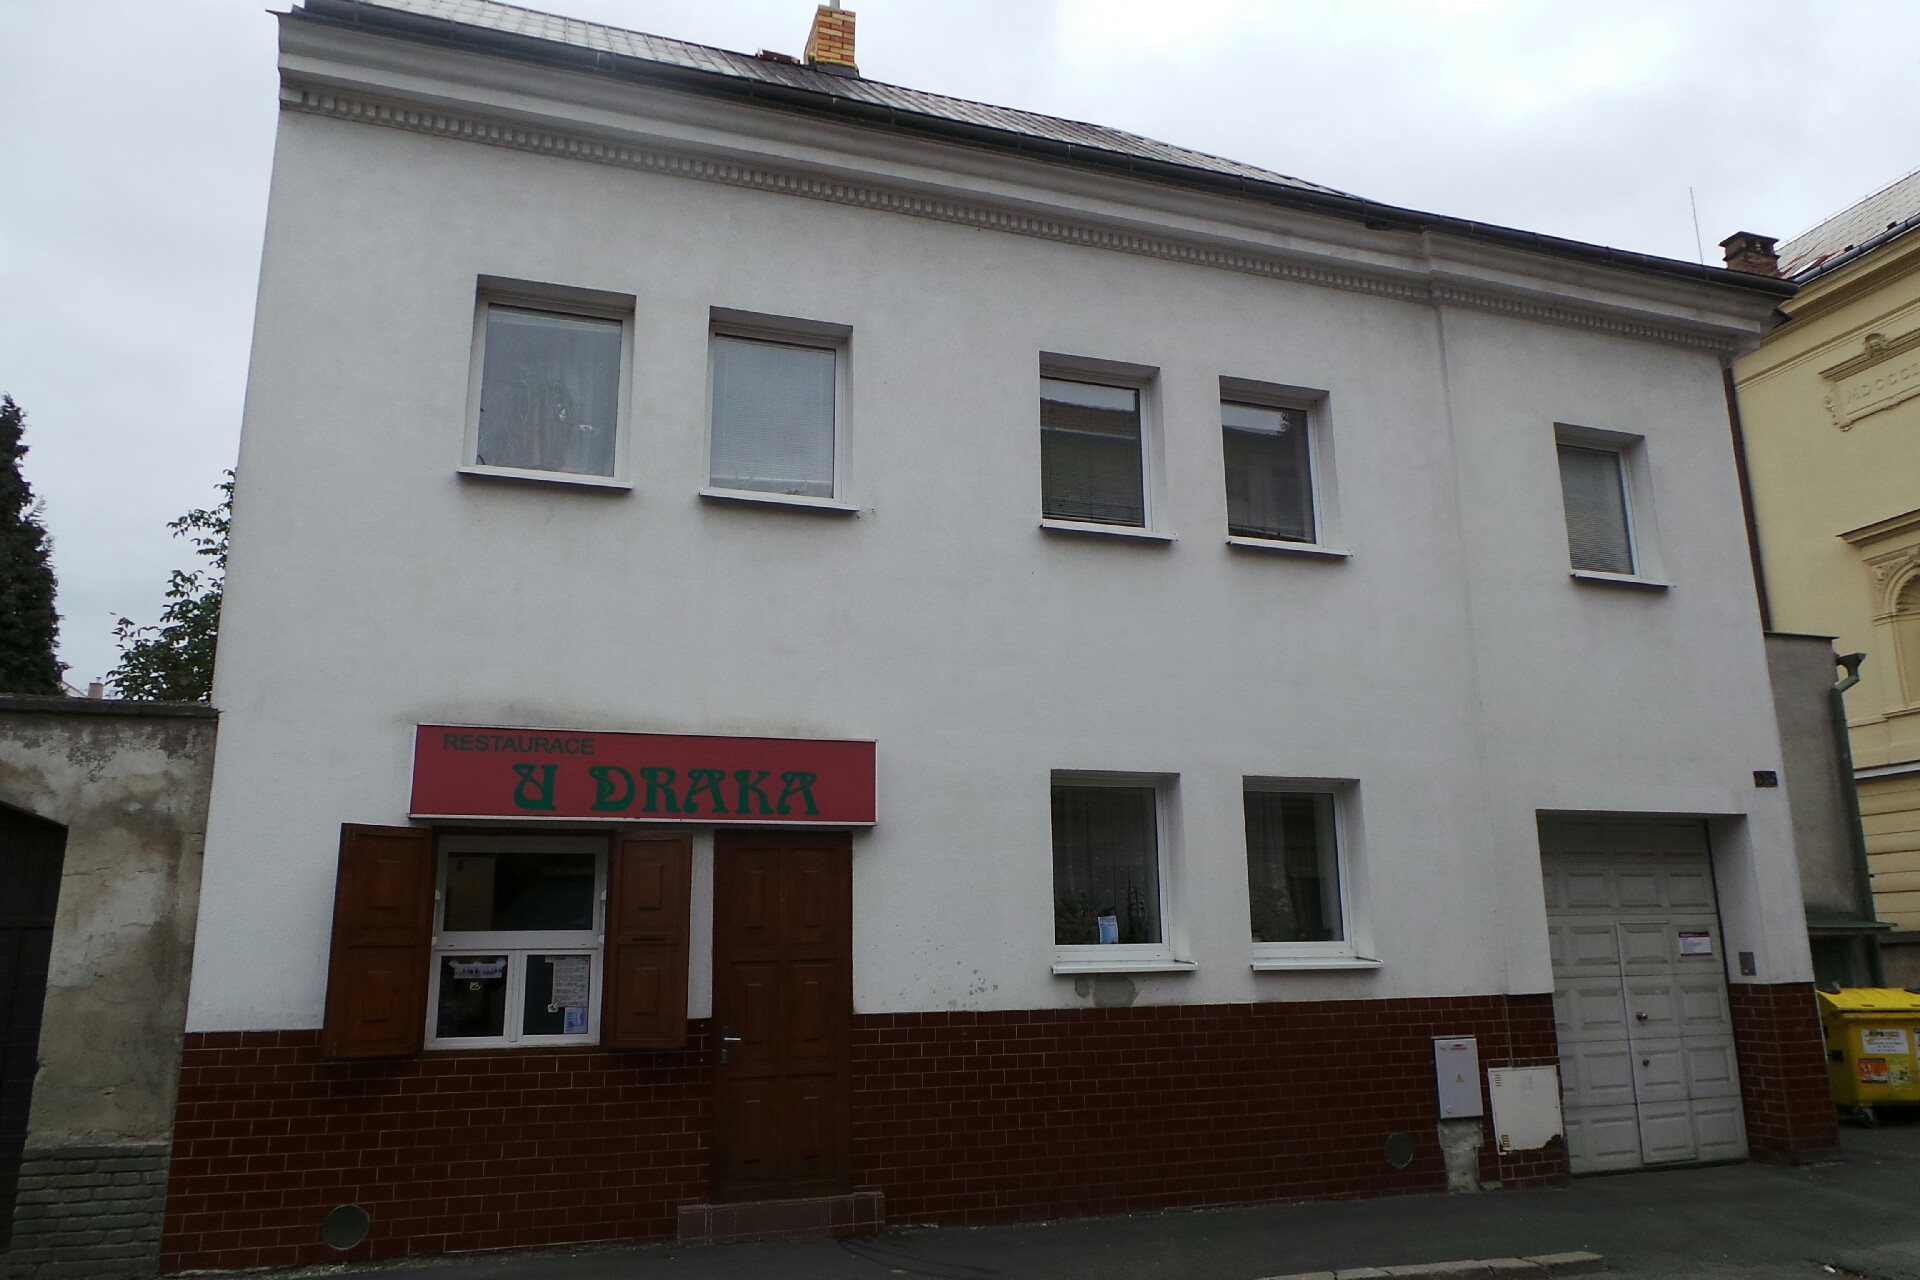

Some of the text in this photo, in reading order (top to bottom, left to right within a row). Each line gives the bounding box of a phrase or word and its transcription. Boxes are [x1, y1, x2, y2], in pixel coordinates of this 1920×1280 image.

[443, 733, 595, 755] RESTAURACE
[512, 762, 821, 816] U DRAKA
